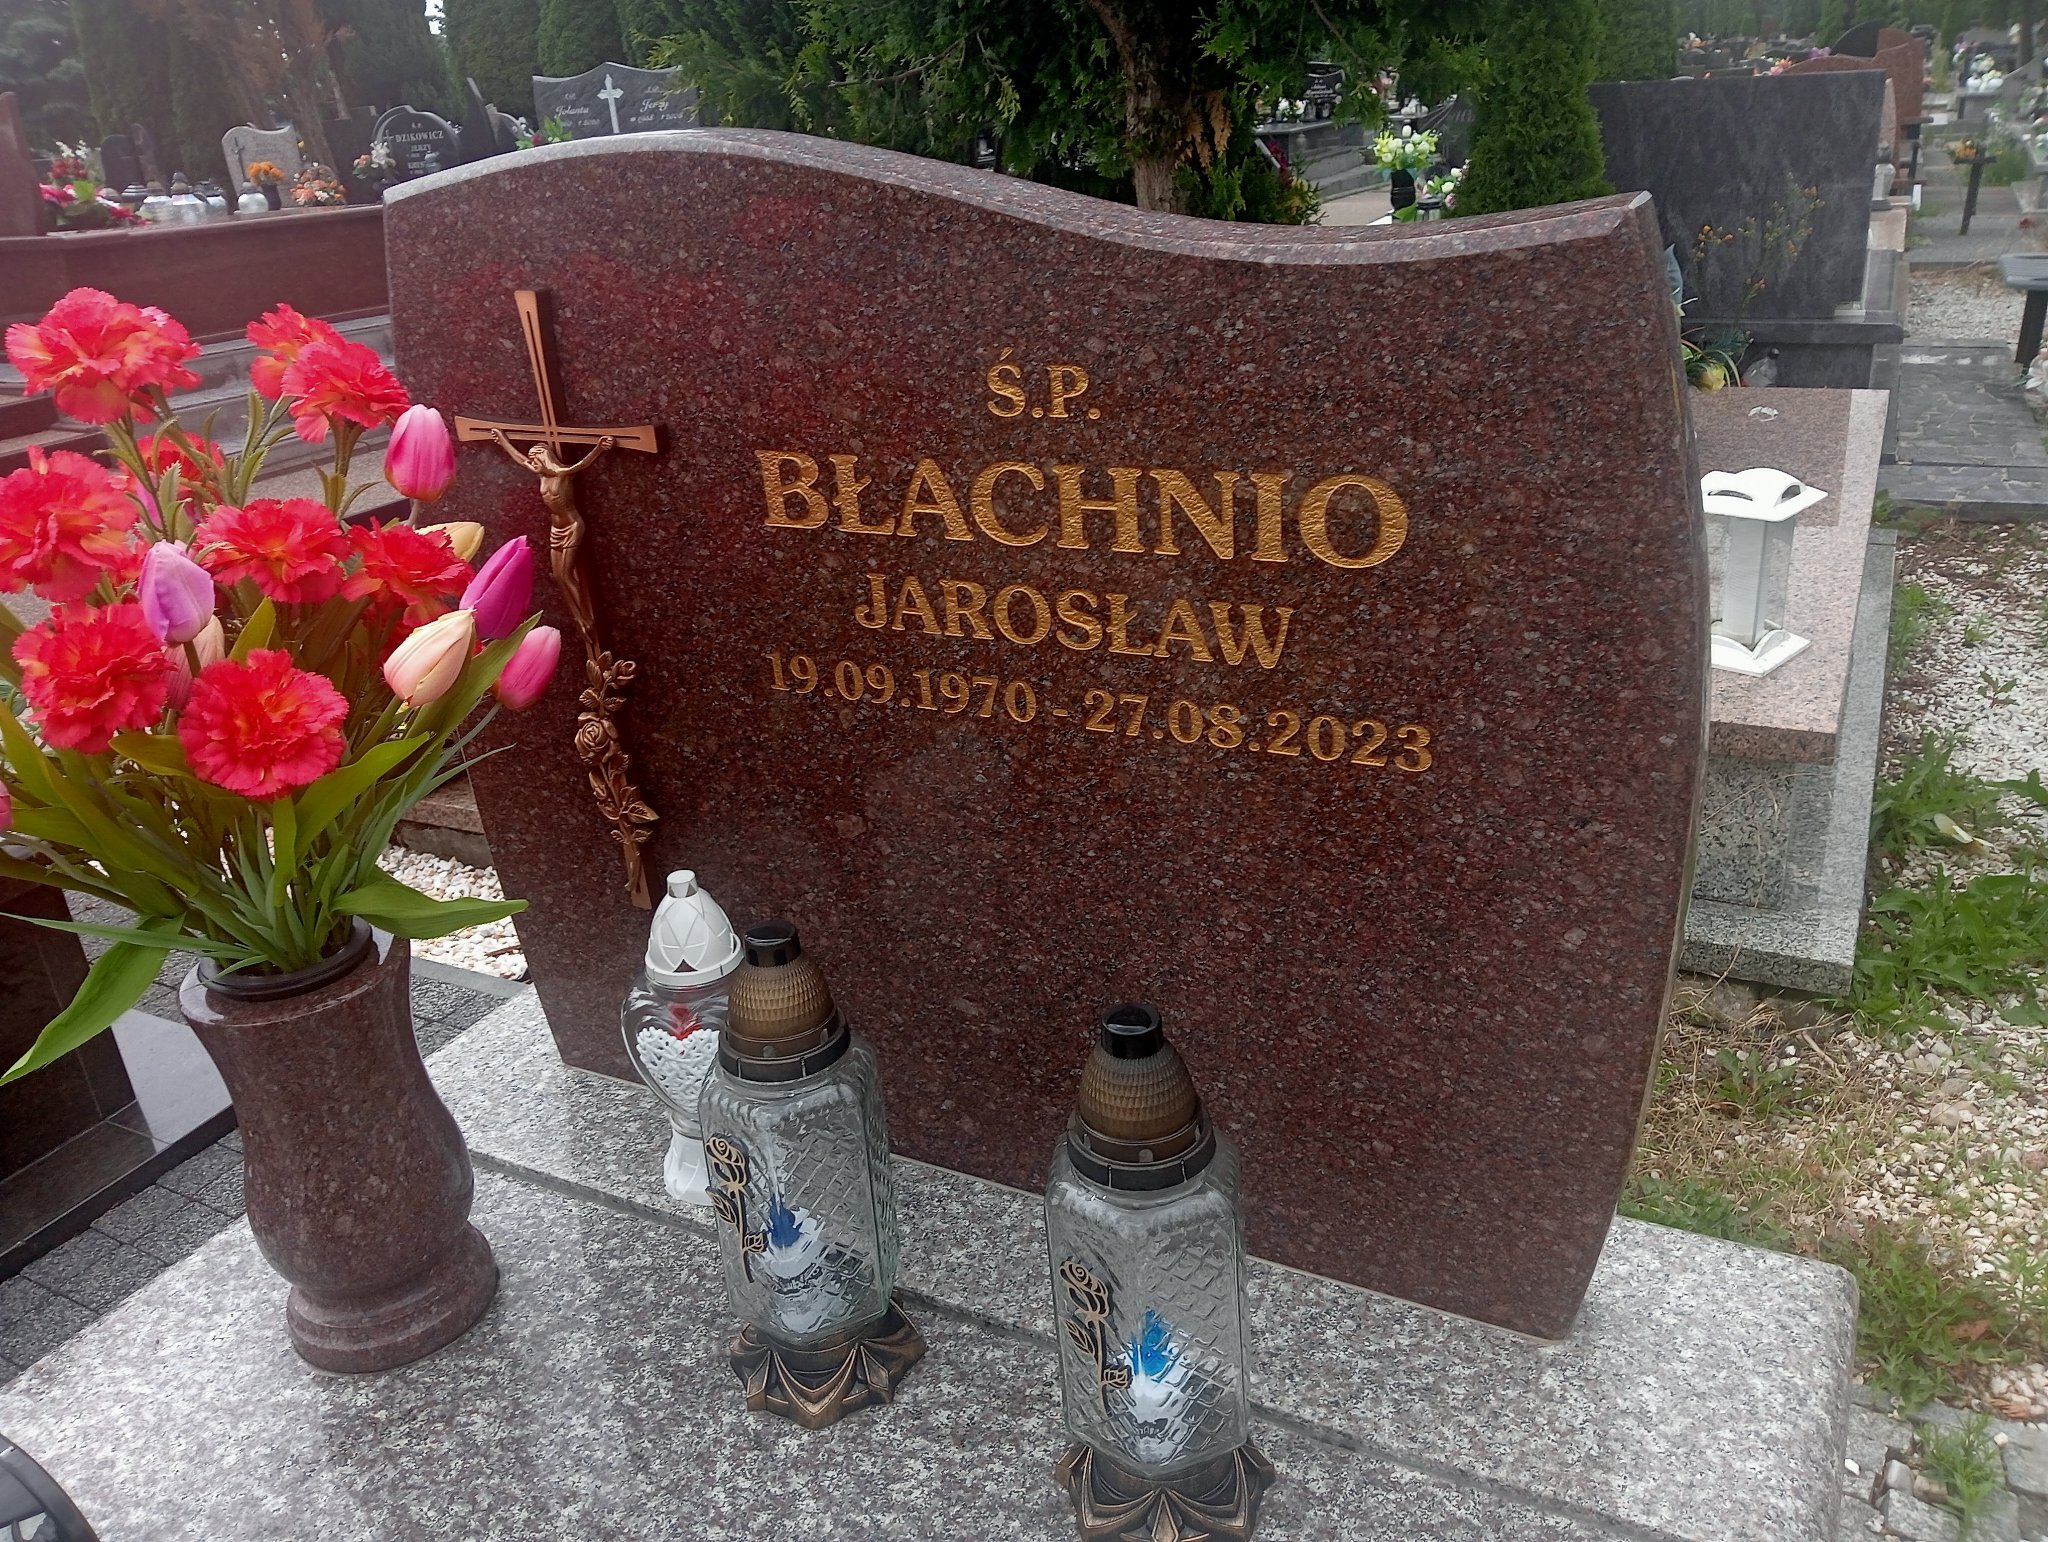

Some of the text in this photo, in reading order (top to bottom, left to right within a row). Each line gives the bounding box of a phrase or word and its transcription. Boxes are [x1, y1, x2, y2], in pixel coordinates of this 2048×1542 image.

[395, 130, 444, 142] DZIKOWICZ
[986, 347, 1101, 420] Ś.P.
[755, 449, 1409, 568] BŁACHNIO
[855, 574, 1292, 669] JAROSŁAW
[768, 652, 1037, 722] 19.09.1970
[1084, 689, 1433, 772] 27.08.2023
